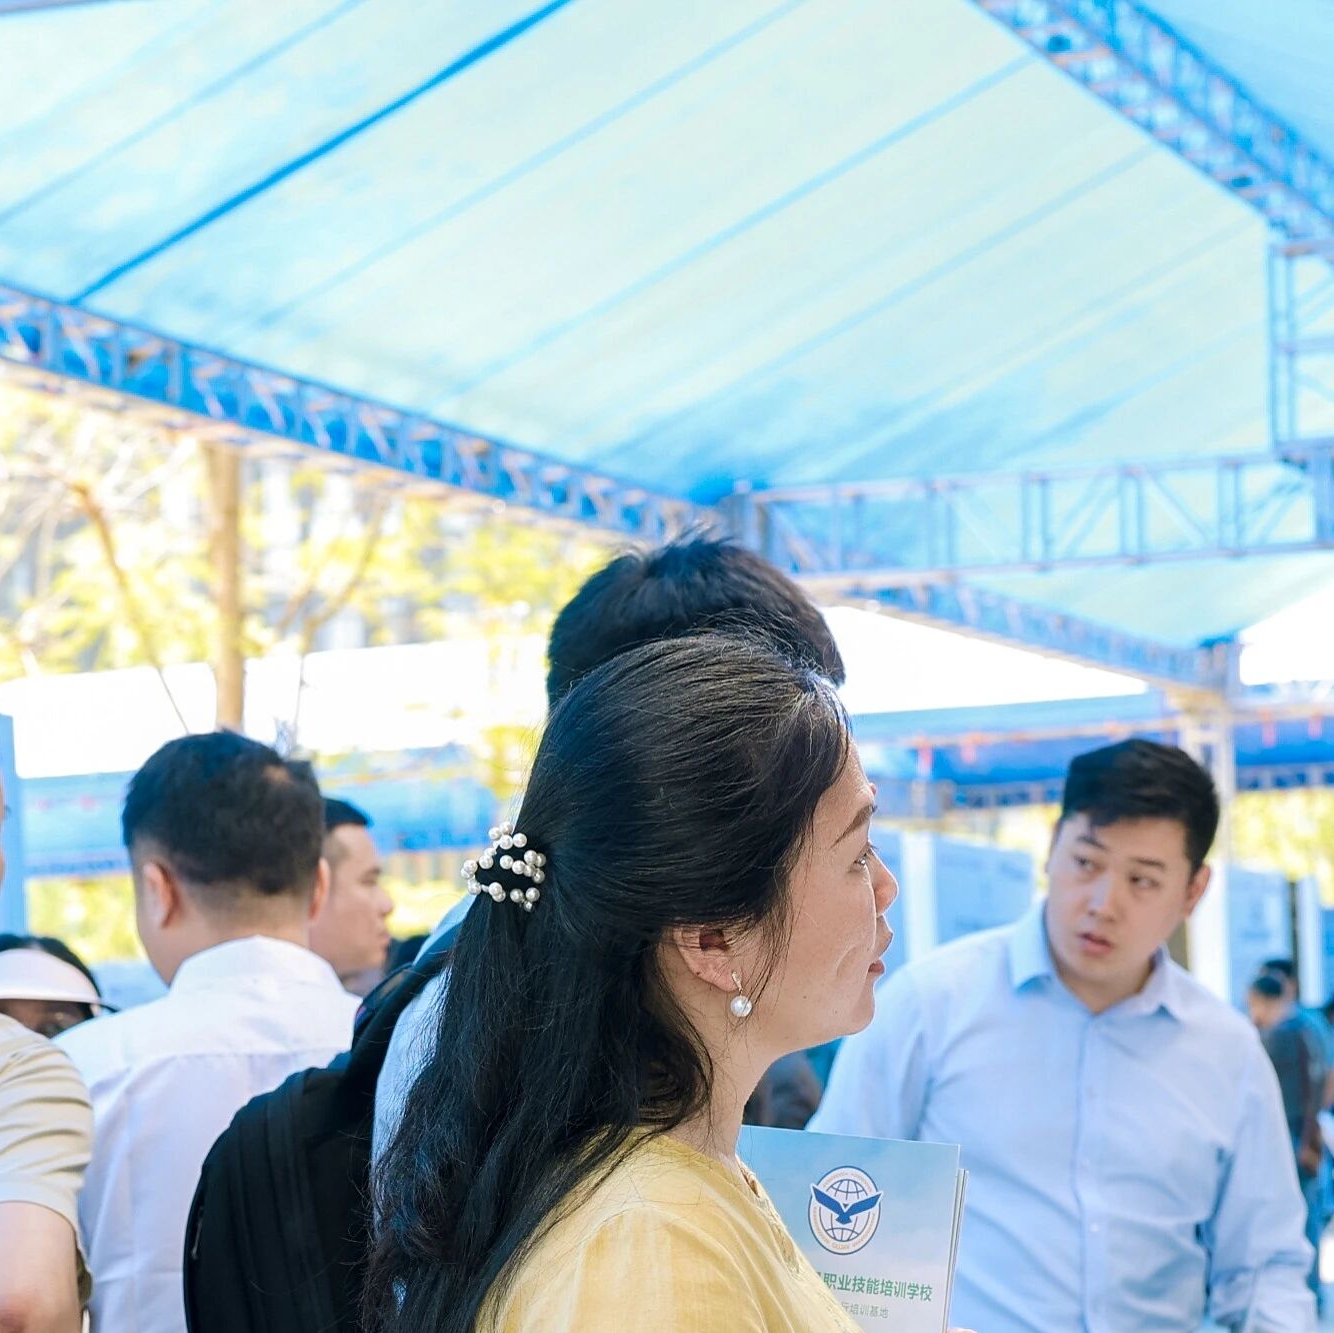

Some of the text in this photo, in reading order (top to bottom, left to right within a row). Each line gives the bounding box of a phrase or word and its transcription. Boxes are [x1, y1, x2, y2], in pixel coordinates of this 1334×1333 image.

[817, 1271, 933, 1302] 职业技能培训学校
